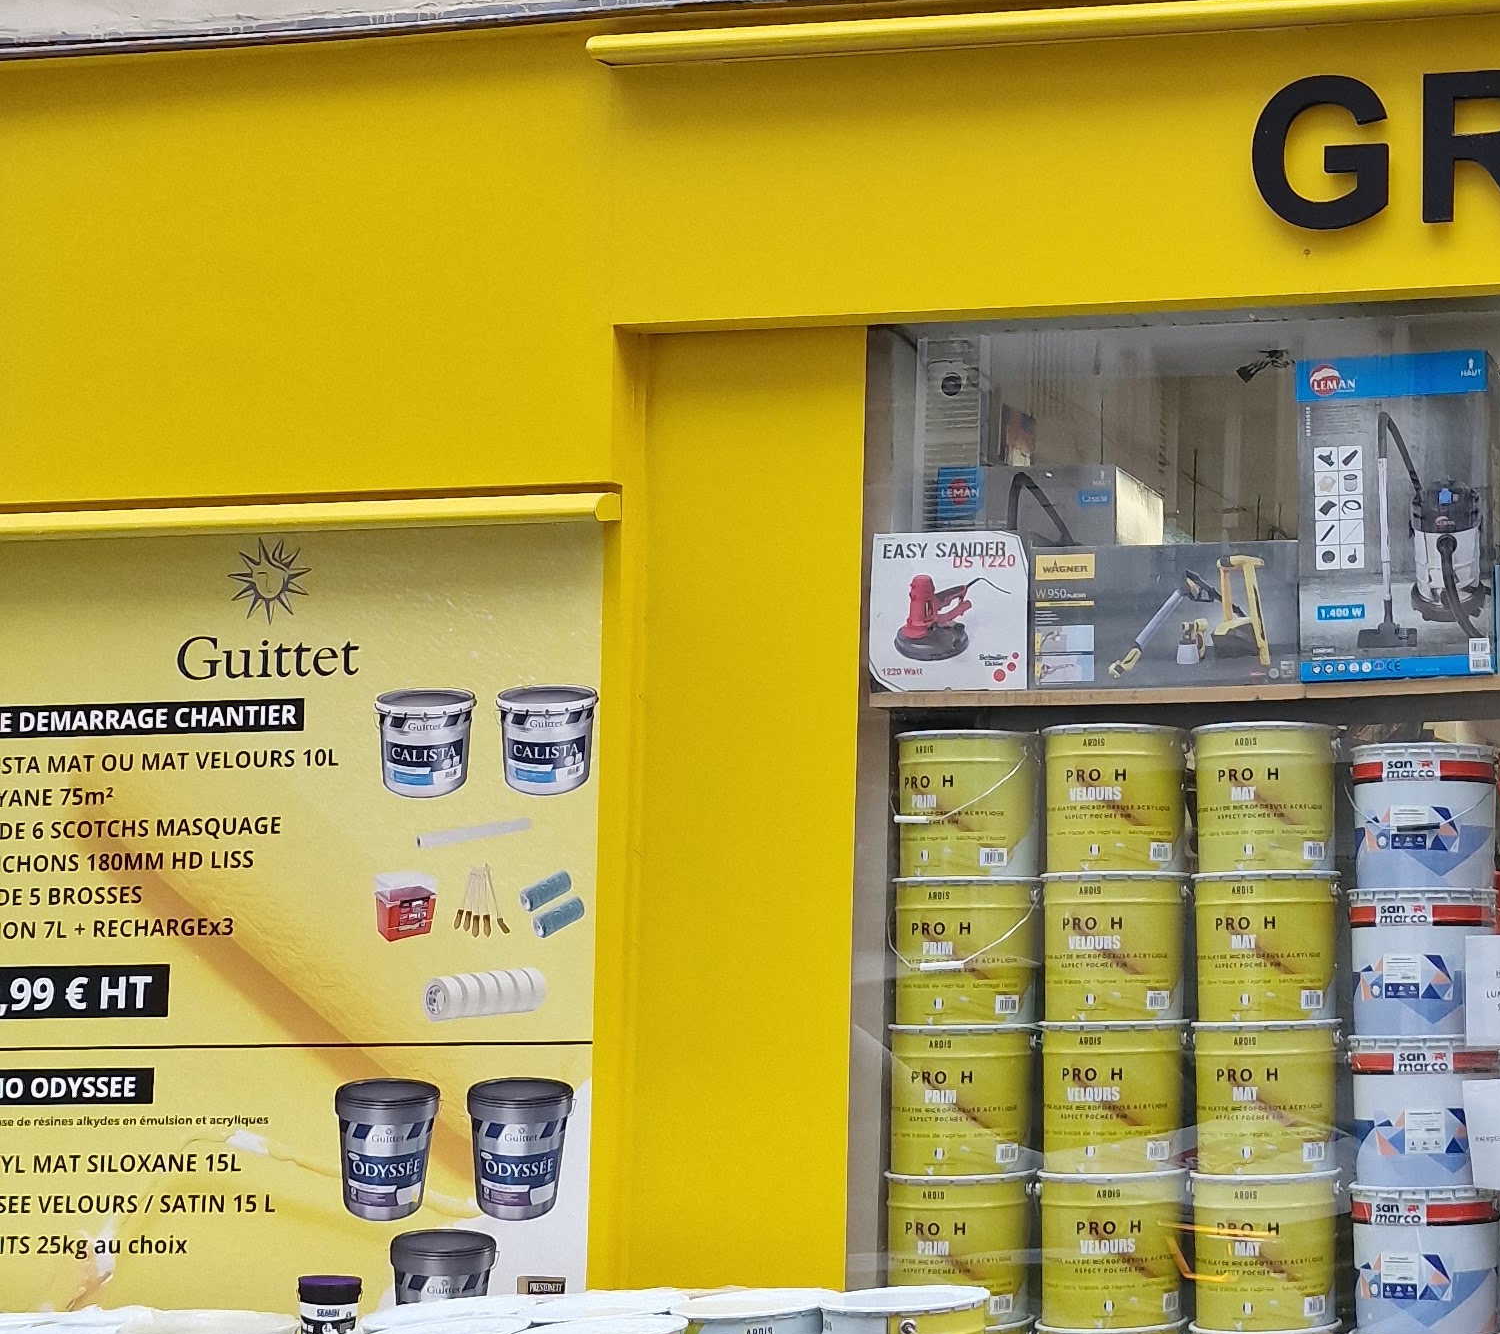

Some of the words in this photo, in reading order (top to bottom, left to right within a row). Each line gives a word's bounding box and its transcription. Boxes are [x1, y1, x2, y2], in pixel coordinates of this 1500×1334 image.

[1461, 369, 1481, 377] HAUT
[1313, 378, 1356, 391] LEMAN
[941, 489, 979, 497] LEMAN
[883, 542, 928, 559] EASY
[935, 541, 1006, 559] SANDER
[953, 556, 973, 569] DS
[980, 554, 1016, 567] 1220
[1043, 560, 1088, 573] WAGNER
[1320, 608, 1347, 618] 1.400
[1351, 607, 1362, 616] W
[177, 636, 359, 680] Guittet
[19, 708, 168, 732] DEMARRAGE
[175, 705, 297, 728] CHANTIER
[530, 720, 563, 728] Guittet
[408, 723, 441, 732] Guittet
[1083, 738, 1106, 747] ARDIS
[391, 745, 456, 762] CALISTA
[513, 743, 578, 759] CALISTA
[48, 755, 95, 773] MAT
[102, 754, 134, 771] OU
[142, 752, 189, 770] MAT
[196, 750, 295, 769] VELOURS
[303, 749, 339, 766] 10L
[1387, 759, 1412, 769] san
[1066, 769, 1100, 783] PRO
[1114, 769, 1126, 781] H
[1218, 768, 1254, 783] PRO
[1268, 768, 1279, 781] H
[1386, 769, 1434, 779] marco
[1069, 787, 1121, 801] VELOURS
[1231, 787, 1256, 801] MAT
[32, 821, 43, 839] 6
[51, 819, 149, 839] SCOTCHS
[156, 817, 281, 839] MASQUAGE
[87, 853, 164, 871] 180MM
[172, 852, 202, 869] HD
[211, 851, 254, 868] LISS
[30, 888, 40, 905] 5
[48, 886, 142, 905] BROSSES
[928, 891, 950, 901] ARDIS
[1380, 905, 1406, 914] san
[1380, 914, 1428, 924] marco
[44, 921, 67, 938] 7L
[93, 918, 233, 938] RECHARGEx3
[912, 922, 945, 935] PRO
[960, 922, 971, 935] H
[923, 942, 952, 955] PRIM
[65, 977, 88, 1010] €
[100, 976, 152, 1009] HT
[1399, 1052, 1426, 1062] san
[1062, 1068, 1097, 1081] PRO
[1111, 1068, 1123, 1080] H
[1398, 1062, 1448, 1073] marco
[31, 1077, 136, 1098] ODYSSEE
[1067, 1087, 1120, 1101] VELOURS
[17, 1117, 31, 1126] de
[34, 1117, 74, 1126] résines
[77, 1116, 120, 1128] alkydes
[140, 1115, 192, 1125] émulsion
[196, 1116, 207, 1125] et
[210, 1115, 269, 1127] acryliques
[33, 1155, 81, 1173] MAT
[87, 1154, 196, 1172] SILOXANE
[206, 1154, 241, 1172] 15L
[352, 1153, 421, 1178] ODYSSÉE
[485, 1152, 553, 1176] ODYSSÉE
[38, 1195, 137, 1213] VELOURS
[144, 1195, 154, 1213] /
[160, 1194, 225, 1213] SATIN
[233, 1194, 257, 1212] 15
[265, 1194, 275, 1212] L
[906, 1222, 940, 1236] PRO
[954, 1222, 966, 1235] H
[37, 1236, 88, 1259] 25kg
[94, 1239, 120, 1254] au
[128, 1235, 187, 1254] choix
[918, 1241, 949, 1255] PRIM
